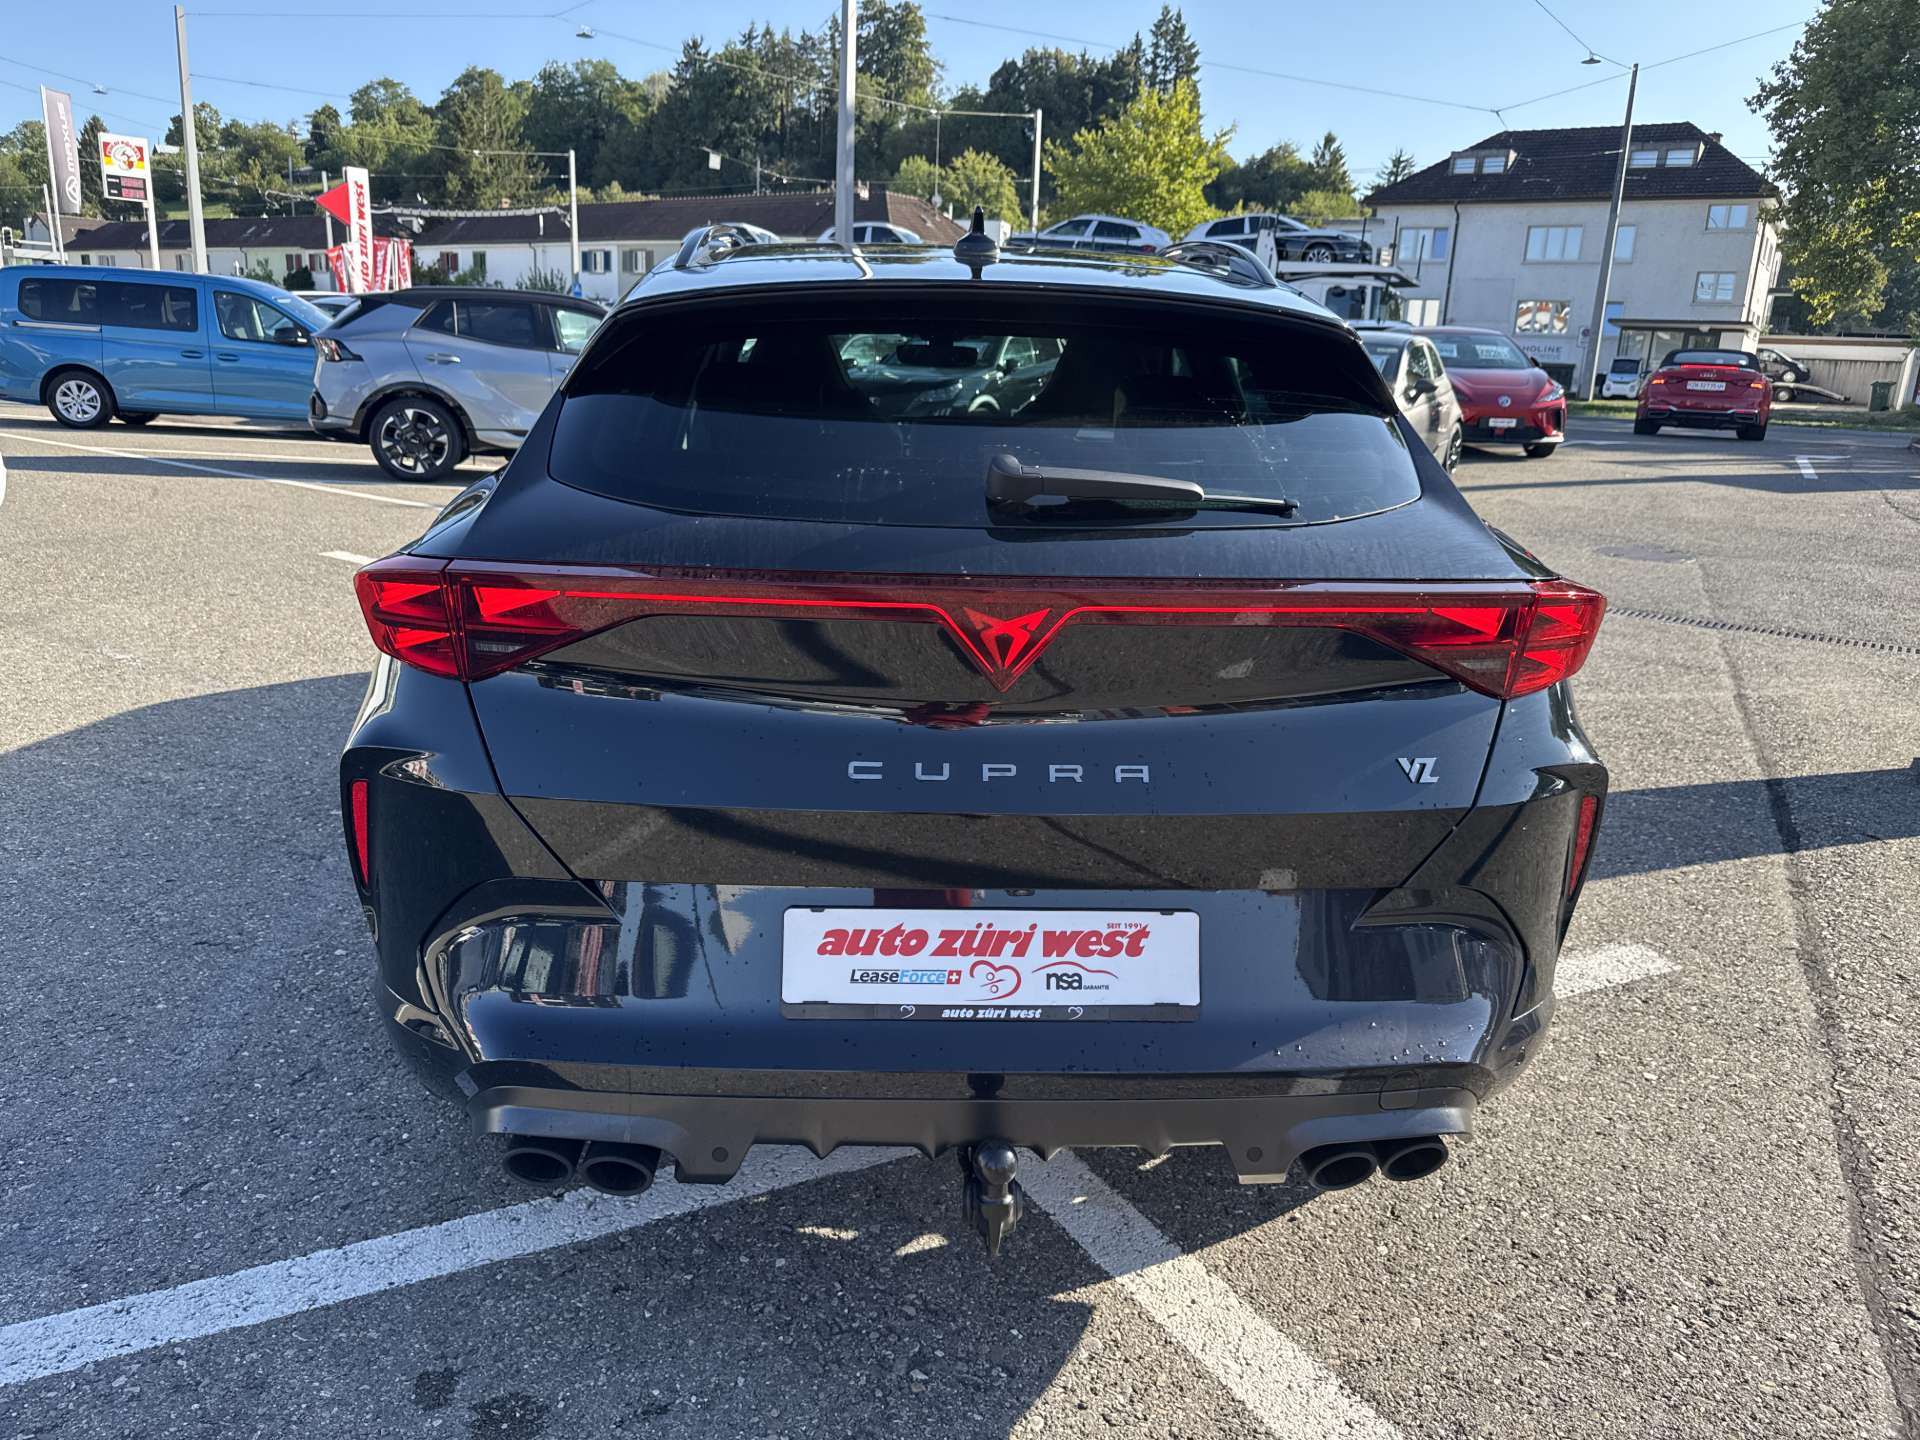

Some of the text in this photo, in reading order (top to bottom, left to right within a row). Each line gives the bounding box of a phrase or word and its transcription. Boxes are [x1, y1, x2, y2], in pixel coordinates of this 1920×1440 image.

[354, 180, 366, 220] west
[848, 761, 1150, 783] CUPRA
[1396, 757, 1440, 783] VZ
[1124, 922, 1143, 930] 1991
[816, 922, 1151, 958] auto züri west
[850, 968, 947, 983] LeaseForce
[1046, 973, 1083, 990] nsa
[941, 1008, 1042, 1019] auto züri west
